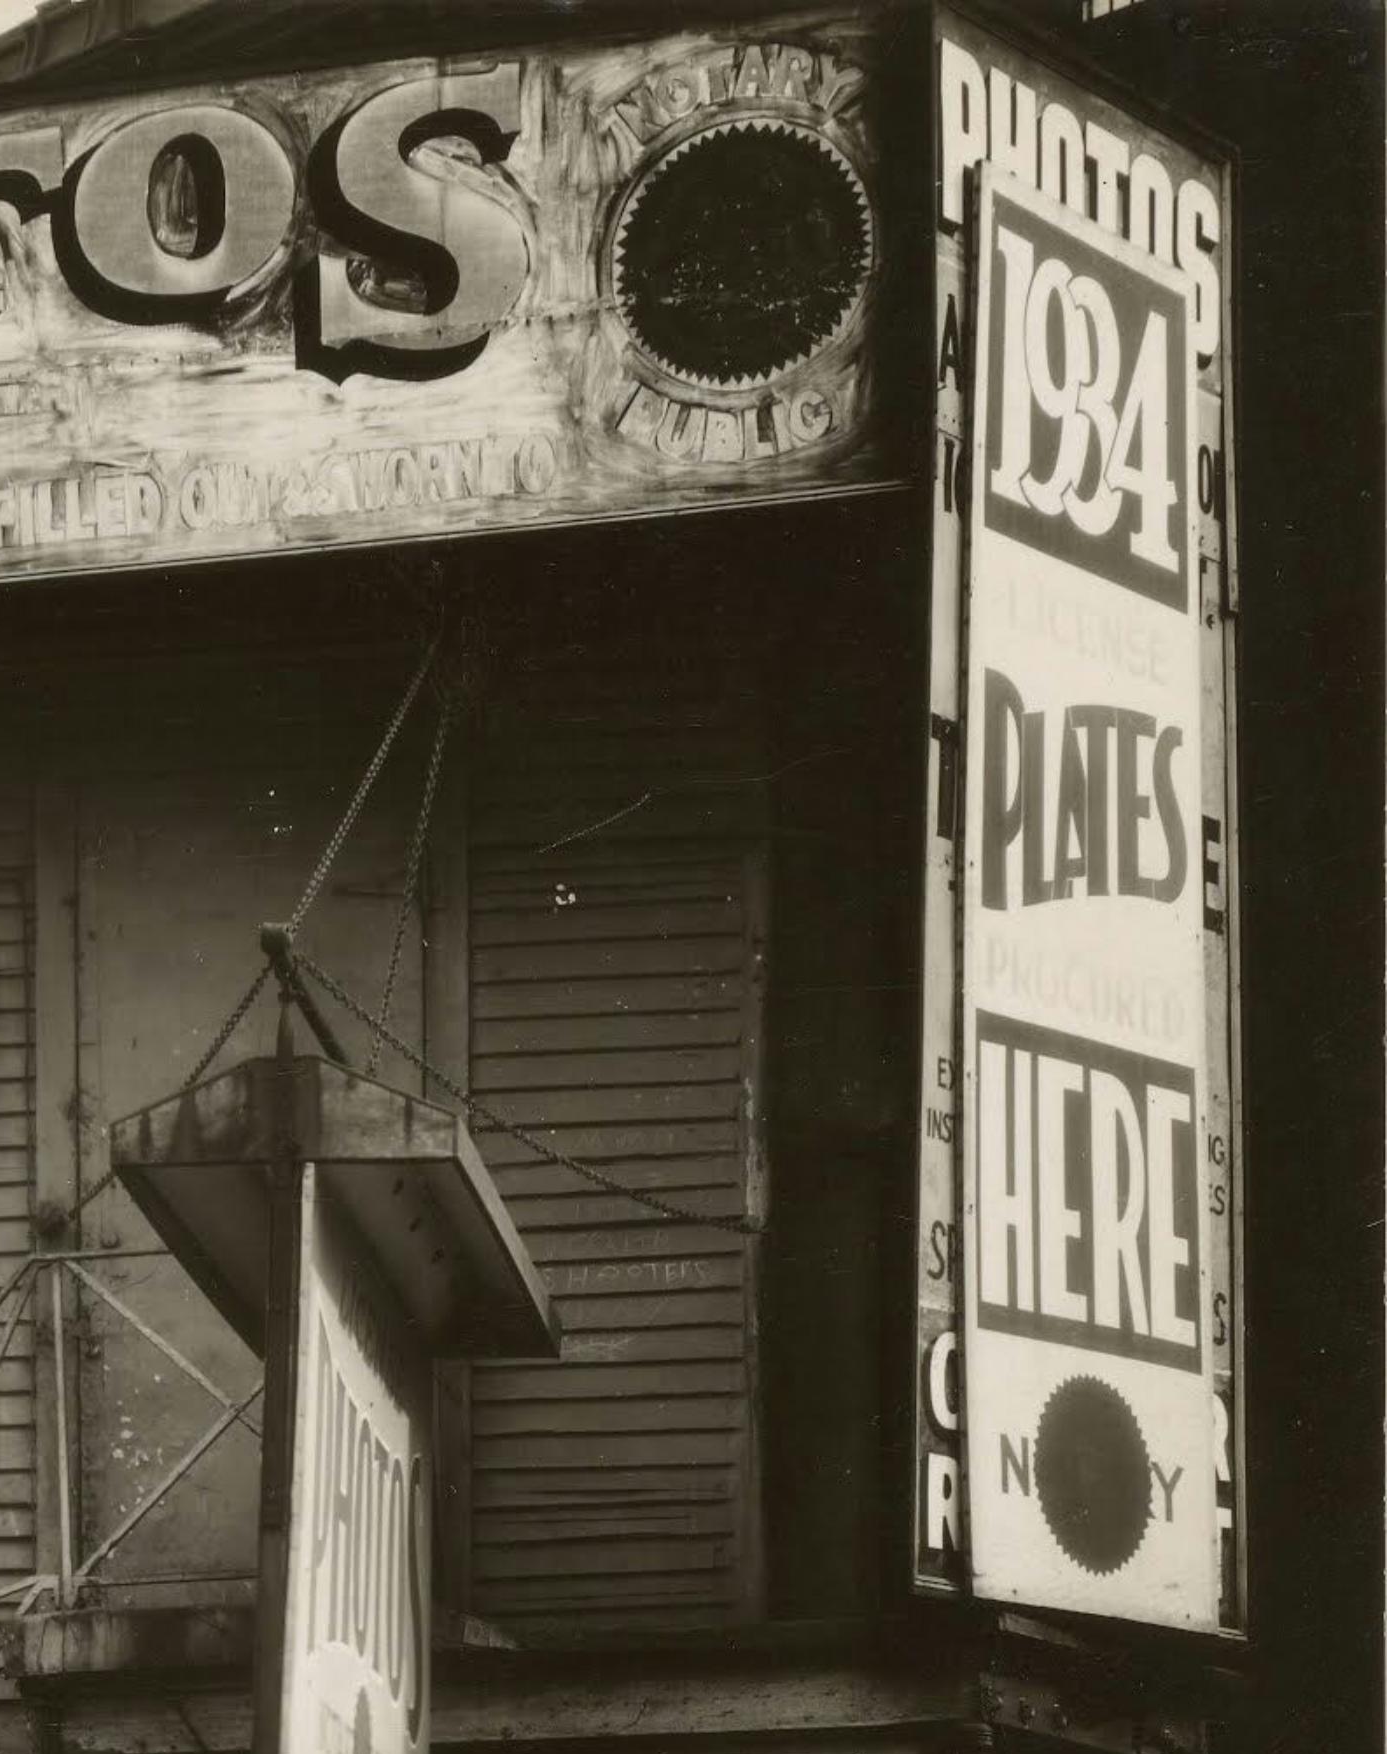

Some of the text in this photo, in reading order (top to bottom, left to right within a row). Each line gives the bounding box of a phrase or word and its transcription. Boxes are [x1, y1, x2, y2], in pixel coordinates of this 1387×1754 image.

[614, 45, 862, 147] NOTARY
[991, 224, 1179, 575] 1934
[981, 667, 1188, 910] PLATES
[979, 1040, 1198, 1348] HERE
[307, 1310, 428, 1750] PHOTOS
